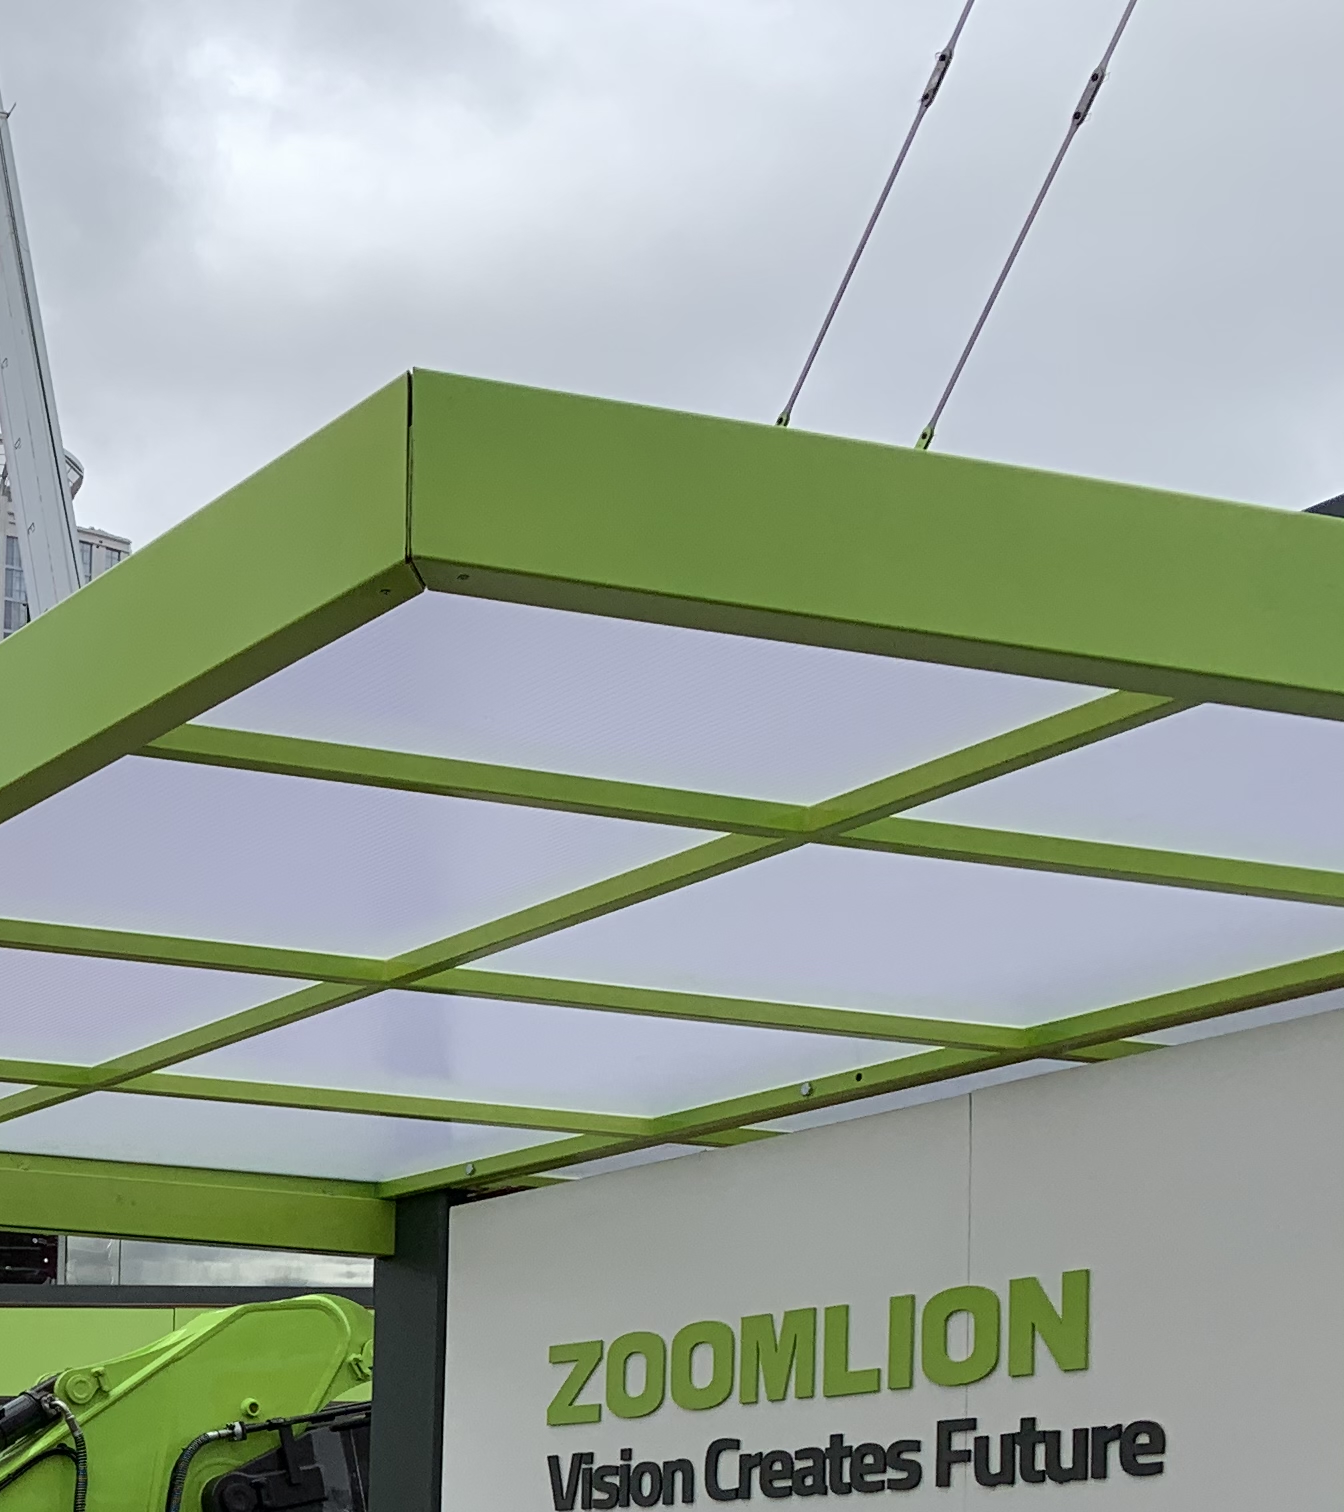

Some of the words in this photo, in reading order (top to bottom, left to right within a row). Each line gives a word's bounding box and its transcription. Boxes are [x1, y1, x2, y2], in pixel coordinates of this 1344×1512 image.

[546, 1268, 1090, 1427] ZOOMLION
[546, 1447, 694, 1512] Vision
[703, 1433, 922, 1502] Creates
[935, 1416, 1166, 1488] Future
